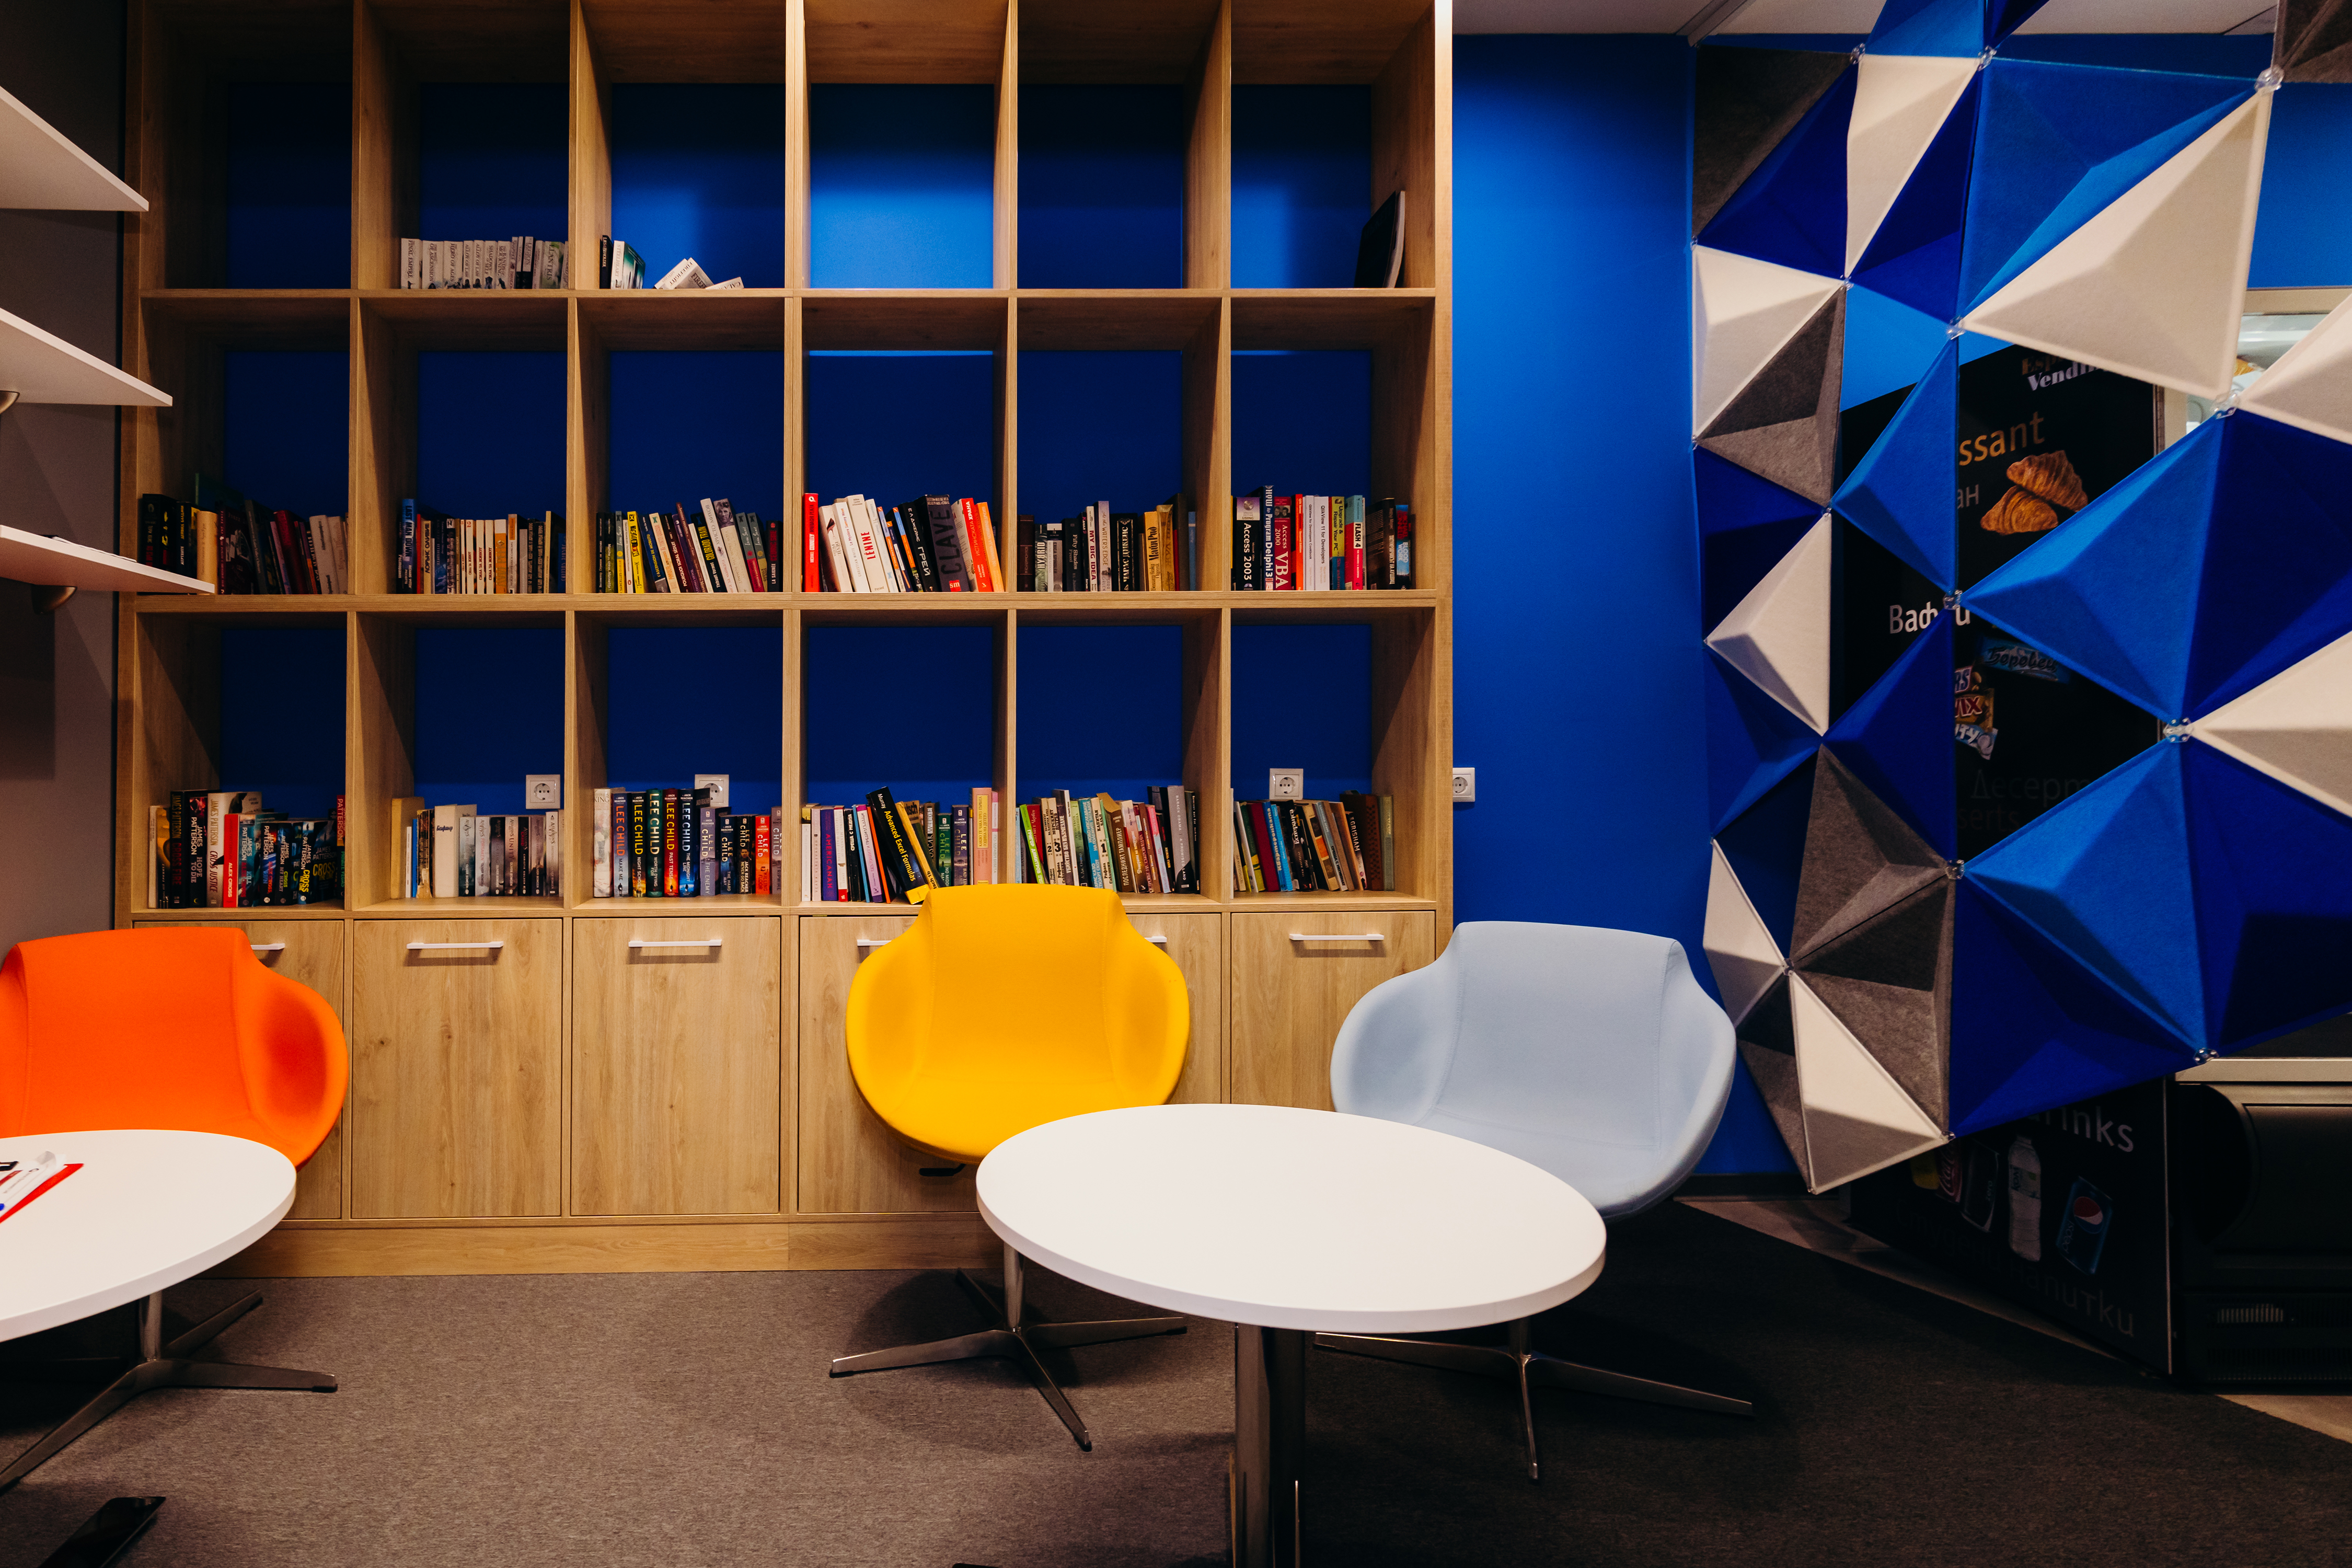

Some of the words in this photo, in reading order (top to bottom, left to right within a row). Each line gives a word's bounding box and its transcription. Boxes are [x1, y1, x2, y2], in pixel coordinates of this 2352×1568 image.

[546, 245, 555, 280] ELANTRIS
[1958, 411, 2045, 466] ssant
[705, 505, 715, 523] МИХОВ
[698, 526, 708, 539] TRAIN
[711, 525, 721, 545] ХРИСТО
[970, 521, 981, 556] ИСТИНСКАТА
[1089, 530, 1094, 543] MY
[1147, 526, 1158, 540] Рид
[1243, 523, 1252, 553] Access
[1264, 514, 1273, 541] Program
[702, 539, 716, 561] COLORADO
[861, 532, 876, 560] LÉNINE
[930, 510, 962, 575] CLAVE
[1121, 526, 1131, 557] ДИКЕНС
[1148, 541, 1159, 561] Майн
[652, 555, 661, 578] L'ASCENSION
[917, 546, 931, 576] ГРЕЙ
[1037, 542, 1045, 569] HYBRID
[1243, 556, 1252, 580] 2003
[1263, 542, 1273, 571] Delphi
[679, 566, 688, 587] POURQUOI
[1275, 551, 1289, 589] VBA
[1888, 601, 1971, 635] Вафи
[172, 794, 180, 810] JAMES
[210, 799, 218, 816] JAMES
[616, 805, 625, 823] LEE
[634, 804, 642, 823] LEE
[650, 793, 659, 815] LEE
[666, 802, 675, 820] LEE
[682, 802, 690, 820] LEE
[878, 793, 887, 809] Murray
[171, 811, 181, 838] PATTERSON
[1957, 804, 2021, 832] serts
[616, 825, 625, 856] CHILD
[635, 824, 643, 855] CHILD
[650, 817, 660, 855] CHILD
[666, 821, 675, 850] CHILD
[682, 822, 691, 851] CHILD
[884, 810, 901, 839] Advanced
[895, 838, 906, 855] Excel
[901, 854, 916, 882] Formulas
[1054, 840, 1062, 852] 3
[1115, 827, 1125, 854] ТАМПЛИЕР
[1350, 821, 1361, 851] GRISHAM
[171, 843, 181, 868] CROSS
[210, 850, 218, 869] CROSS
[316, 846, 331, 854] JAMES
[1030, 848, 1042, 874] ДИМИТРОВ
[1063, 851, 1071, 873] УБИЙСТВО
[172, 869, 181, 885] FIRE
[210, 870, 218, 893] JUSTICE
[313, 863, 335, 877] CROSS
[1120, 854, 1129, 886] ПОСЛЕДНИЯТ
[2033, 1105, 2135, 1152] rinks
[2061, 1219, 2076, 1254] pepsi
